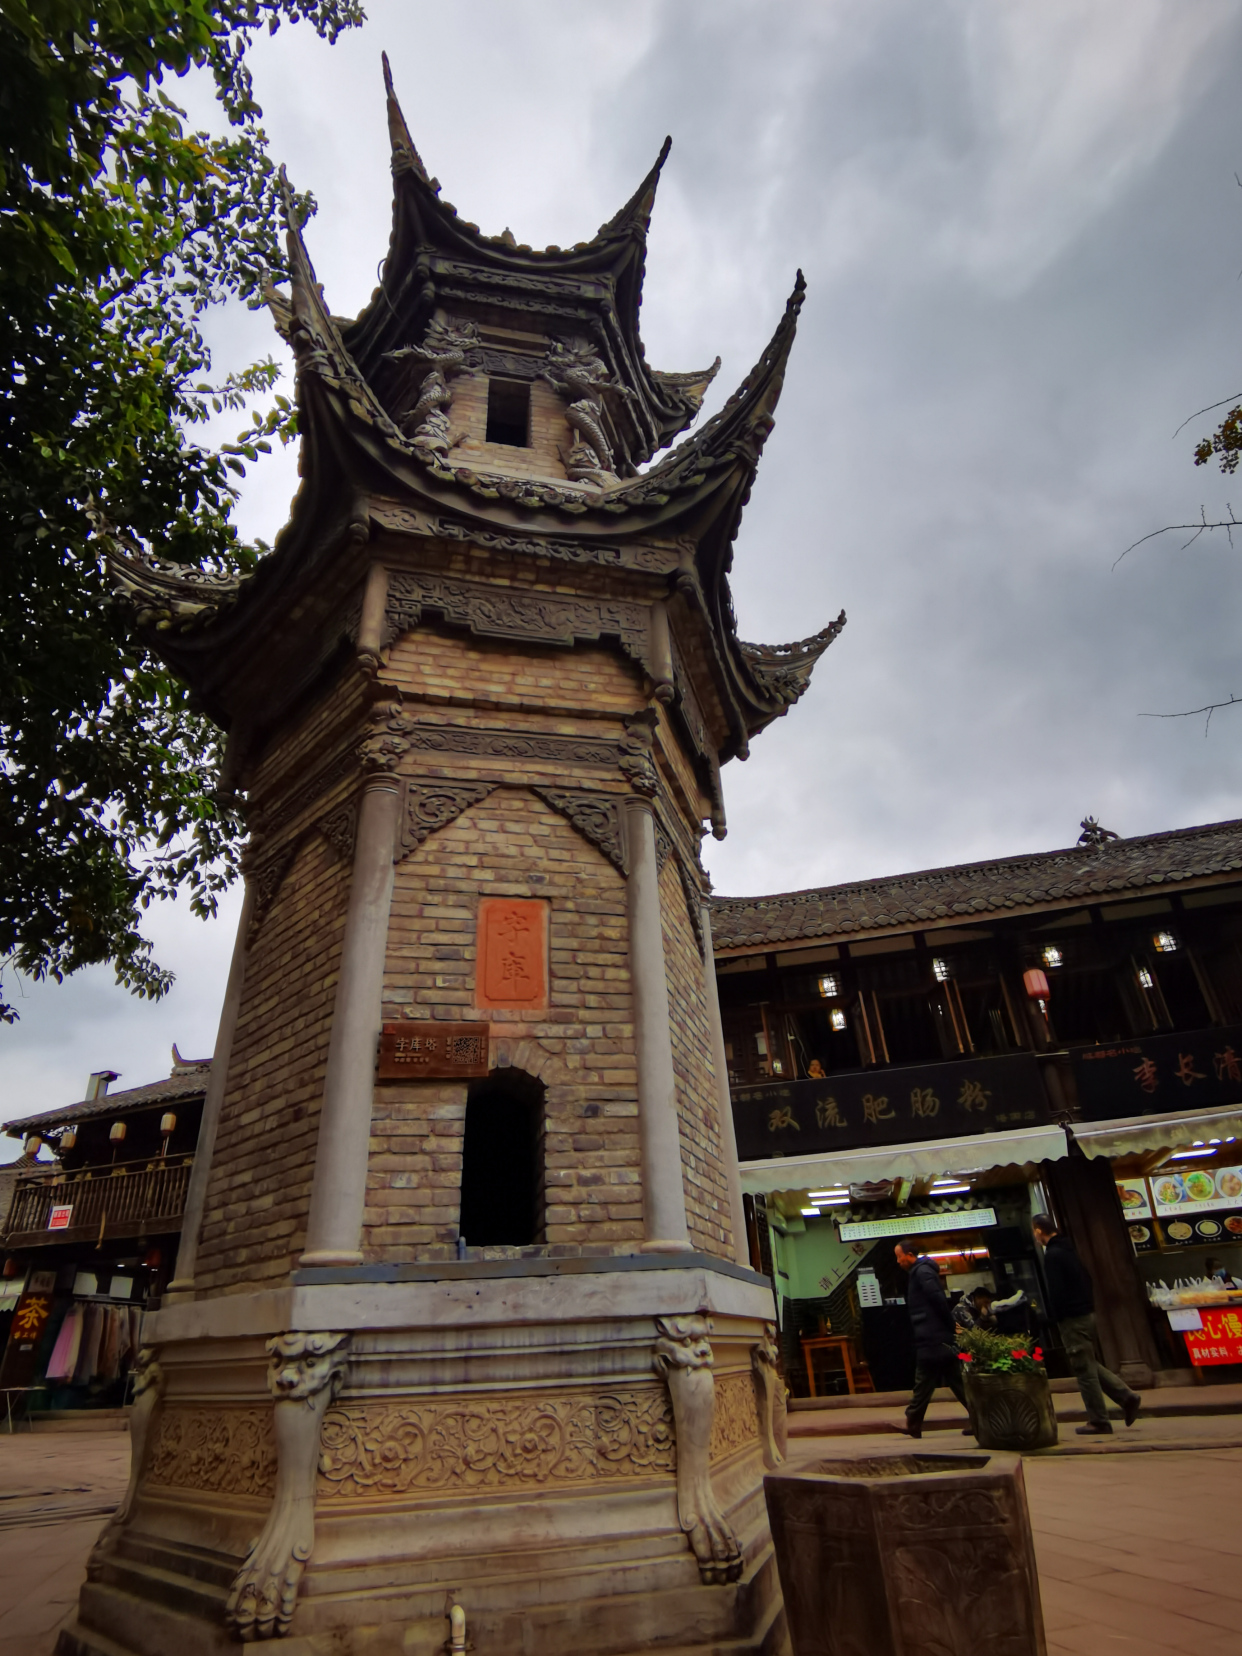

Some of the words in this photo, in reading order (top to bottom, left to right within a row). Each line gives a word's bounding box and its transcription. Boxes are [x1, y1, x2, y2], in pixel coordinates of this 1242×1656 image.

[496, 910, 530, 993] 字庫
[395, 1037, 438, 1052] 字库塔
[767, 1079, 992, 1133] 双流肥肠粉
[819, 1241, 866, 1291] 请上二楼
[18, 1296, 49, 1329] 茶
